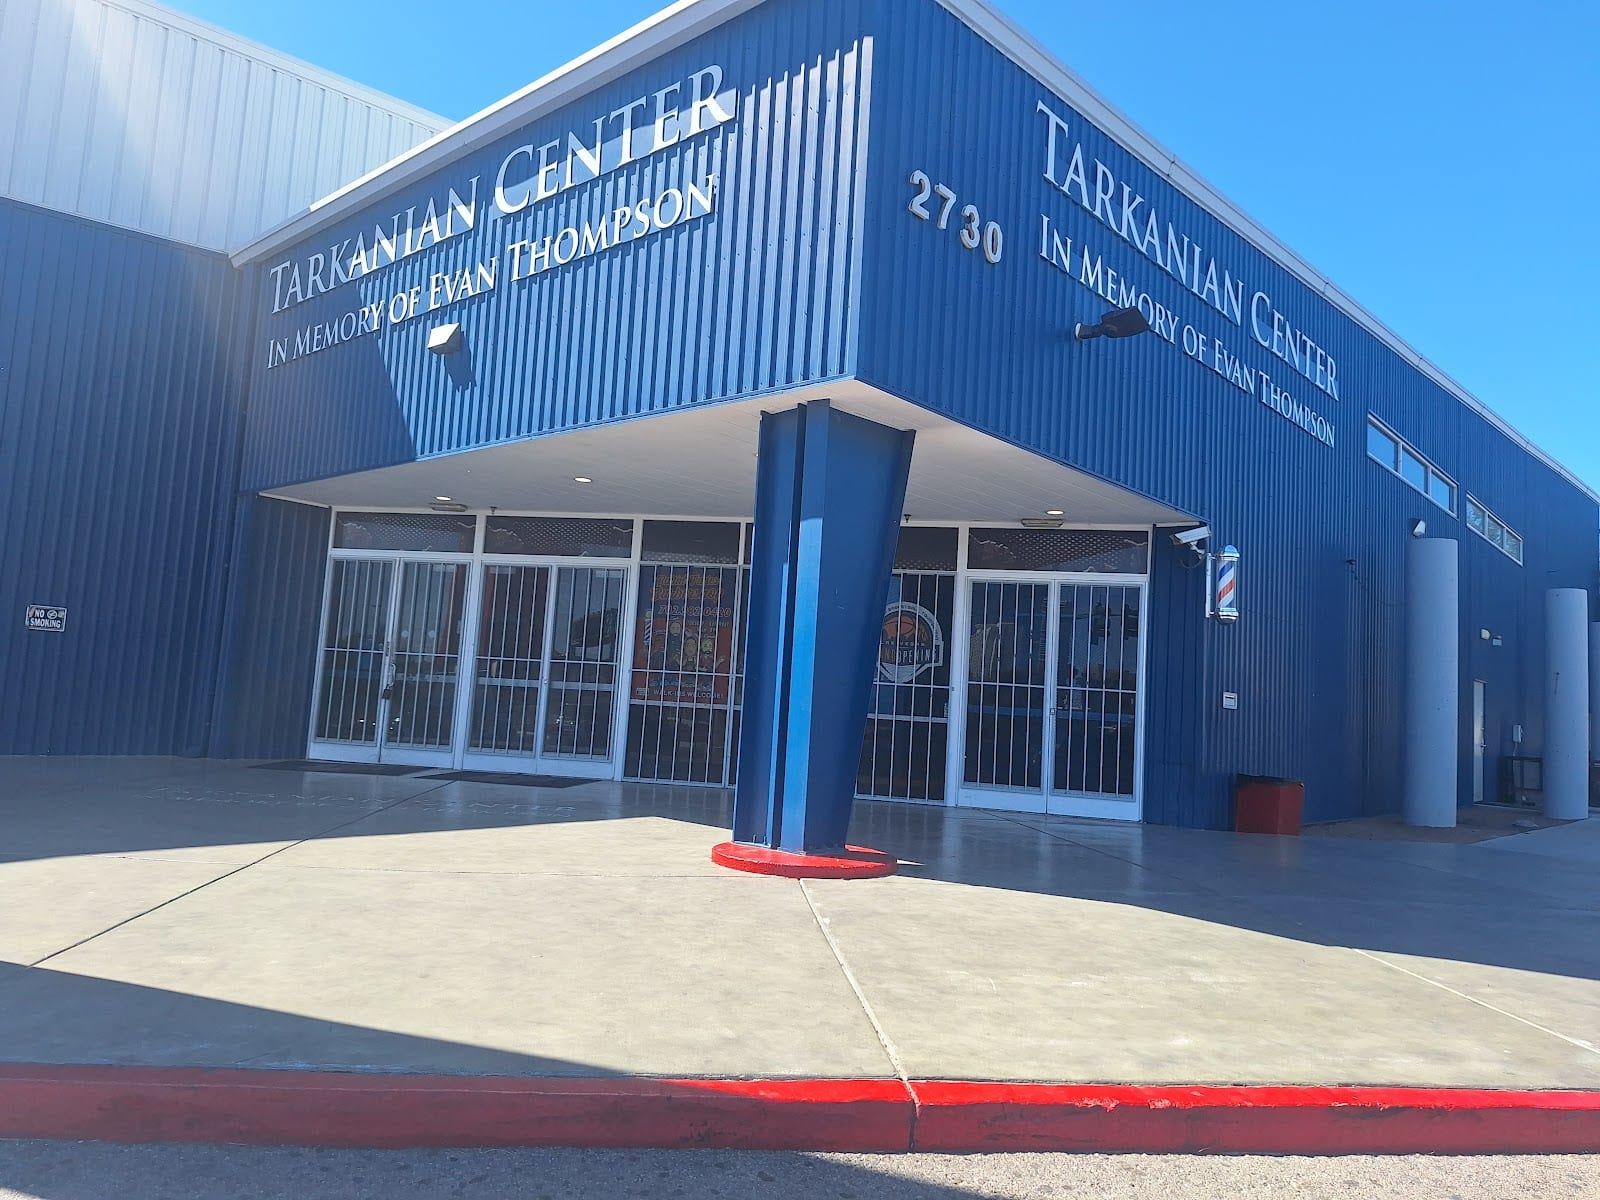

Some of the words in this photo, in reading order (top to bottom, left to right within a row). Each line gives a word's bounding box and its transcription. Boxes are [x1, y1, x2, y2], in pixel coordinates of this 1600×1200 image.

[266, 336, 289, 369] IN
[293, 300, 385, 360] MEMORY
[388, 286, 421, 325] OF
[429, 256, 498, 312] EVAN
[507, 174, 717, 282] THOMPSON
[269, 174, 482, 314] TARKANIAN
[494, 64, 737, 215] CENTER
[908, 169, 1003, 264] 2730
[1036, 99, 1244, 327] TARKANIAN
[1250, 291, 1339, 401] CENTER
[1039, 213, 1073, 274] IN
[1079, 244, 1180, 345] MEMORY
[1182, 325, 1207, 363] OF
[1214, 338, 1255, 396] EVAN
[1259, 370, 1336, 449] THOMPSON
[30, 617, 61, 628] SMOKING
[34, 609, 45, 618] NO
